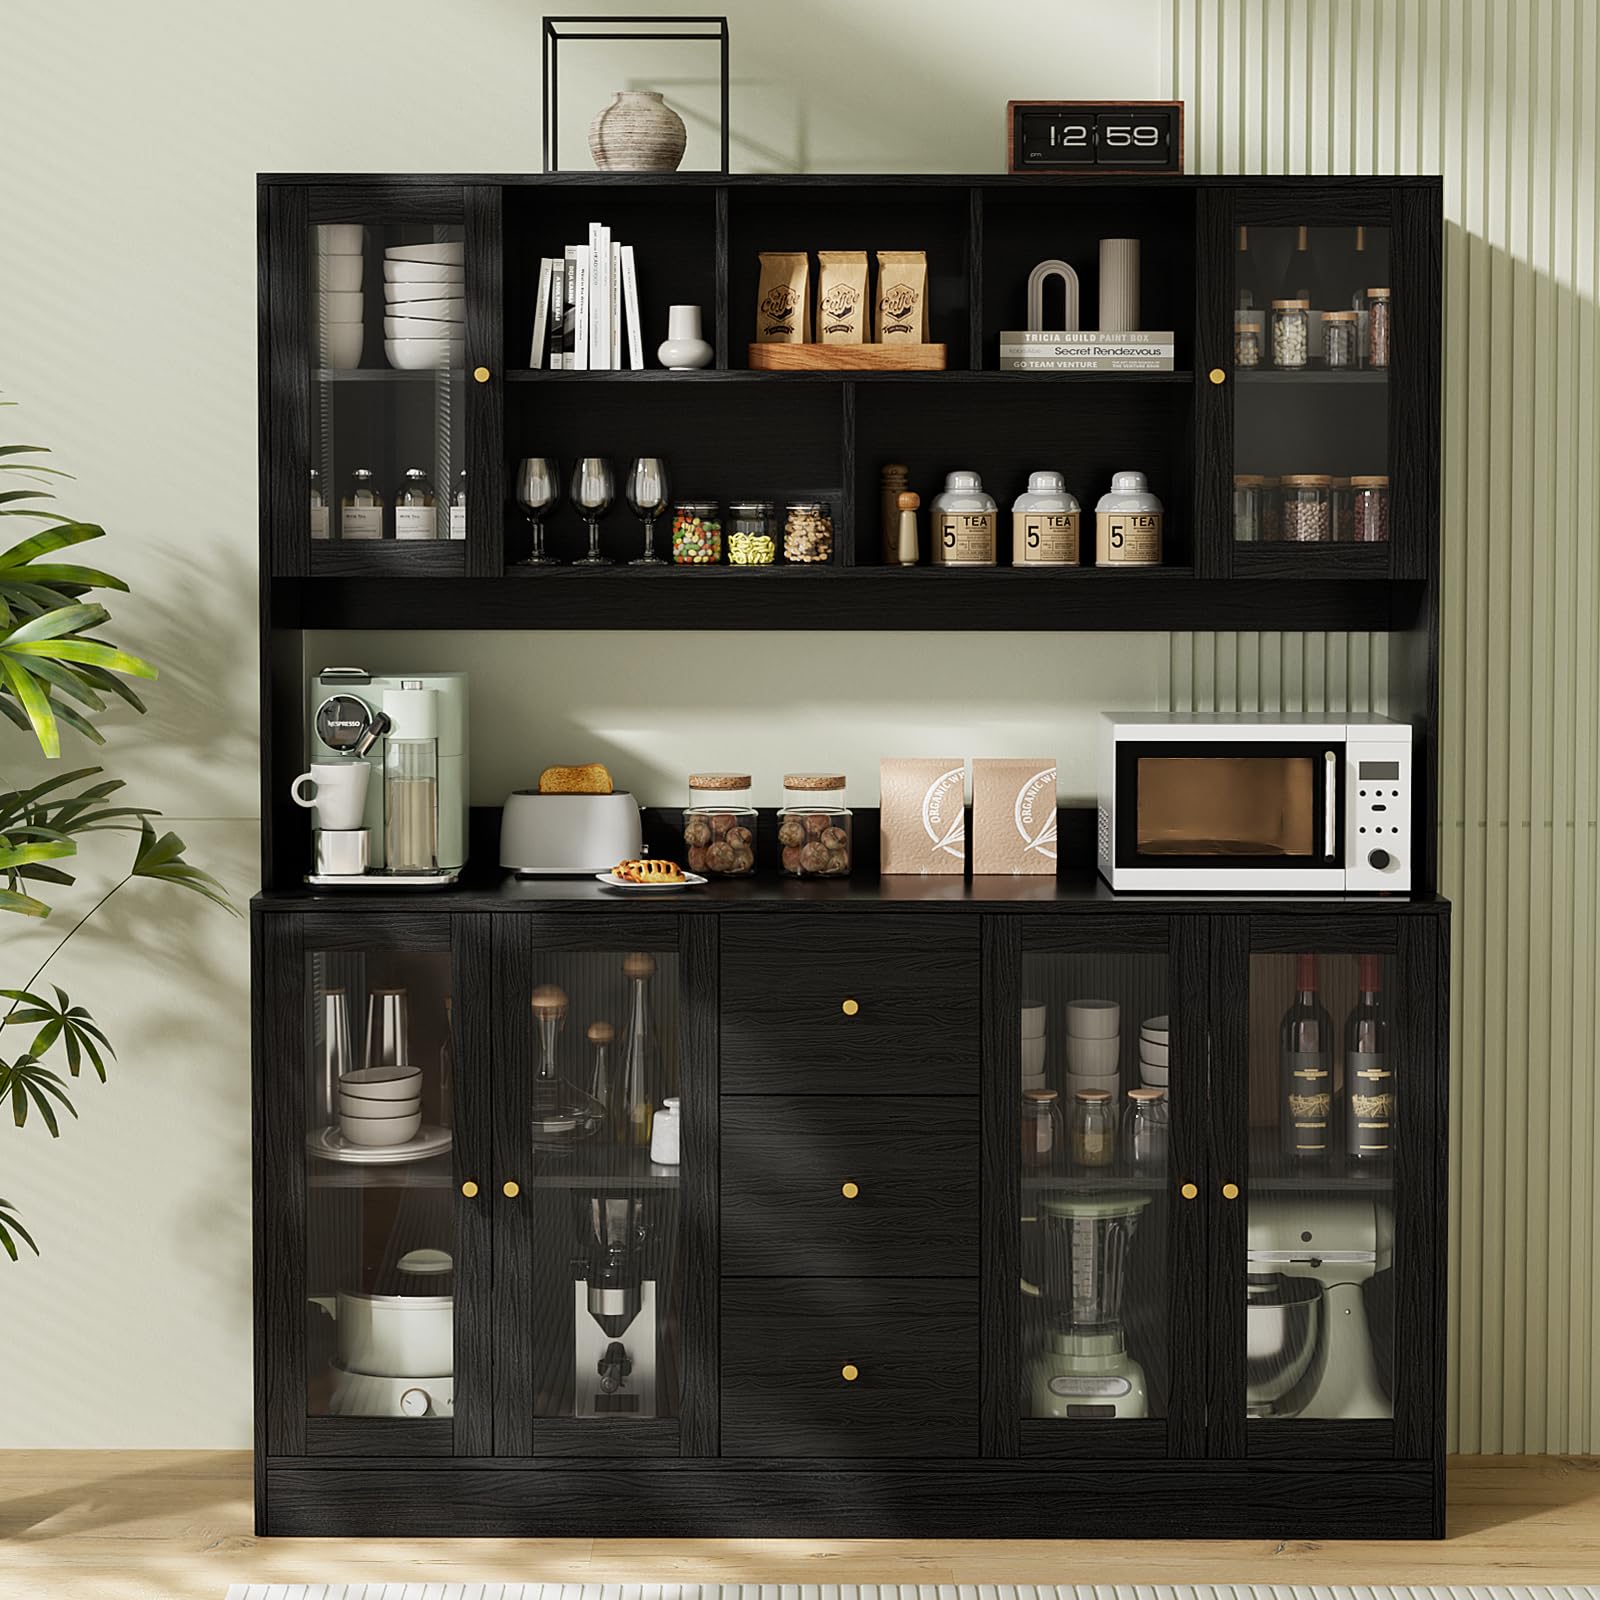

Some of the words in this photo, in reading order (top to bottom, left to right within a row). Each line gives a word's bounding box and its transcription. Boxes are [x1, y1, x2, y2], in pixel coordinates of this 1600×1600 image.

[1050, 126, 1087, 146] 12
[1106, 126, 1158, 146] 59
[1025, 334, 1060, 342] TRICIA
[1065, 334, 1096, 342] GUILD
[1101, 334, 1126, 342] PAINT
[1130, 334, 1149, 342] BOX
[1054, 346, 1090, 356] Secret
[1094, 346, 1161, 356] Rendezvous
[963, 516, 987, 526] TEA
[1047, 516, 1071, 526] TEA
[1131, 516, 1155, 526] TEA
[944, 526, 955, 548] 5
[1028, 526, 1040, 548] 5
[1112, 526, 1123, 548] 5
[930, 781, 951, 823] ORGANIC
[1022, 781, 1043, 823] ORGANIC
